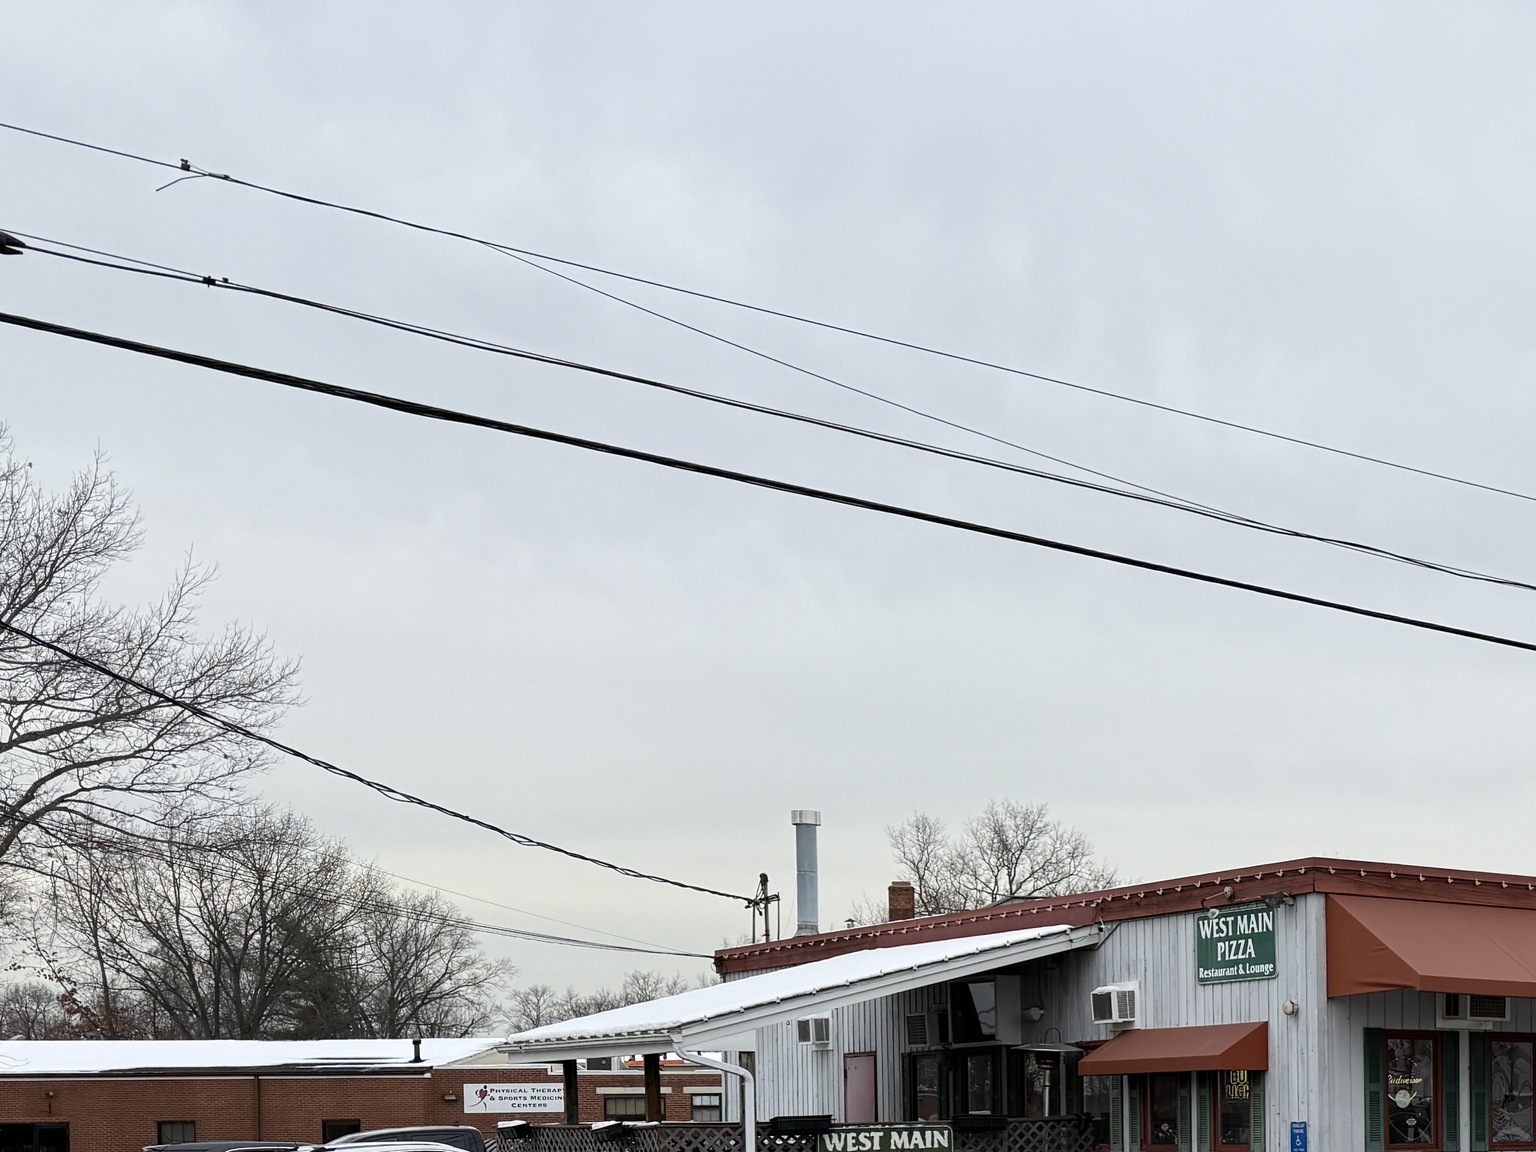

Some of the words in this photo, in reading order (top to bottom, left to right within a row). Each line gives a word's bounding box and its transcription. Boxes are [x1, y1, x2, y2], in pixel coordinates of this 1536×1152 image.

[1199, 917, 1234, 939] WEST
[1237, 911, 1273, 935] MAIN
[1217, 938, 1255, 961] PIZZA
[1199, 965, 1237, 978] Restaurant
[1238, 964, 1245, 974] &
[1246, 963, 1274, 975] Lounge
[823, 1131, 884, 1152] WEST
[890, 1130, 949, 1149] MAIN
